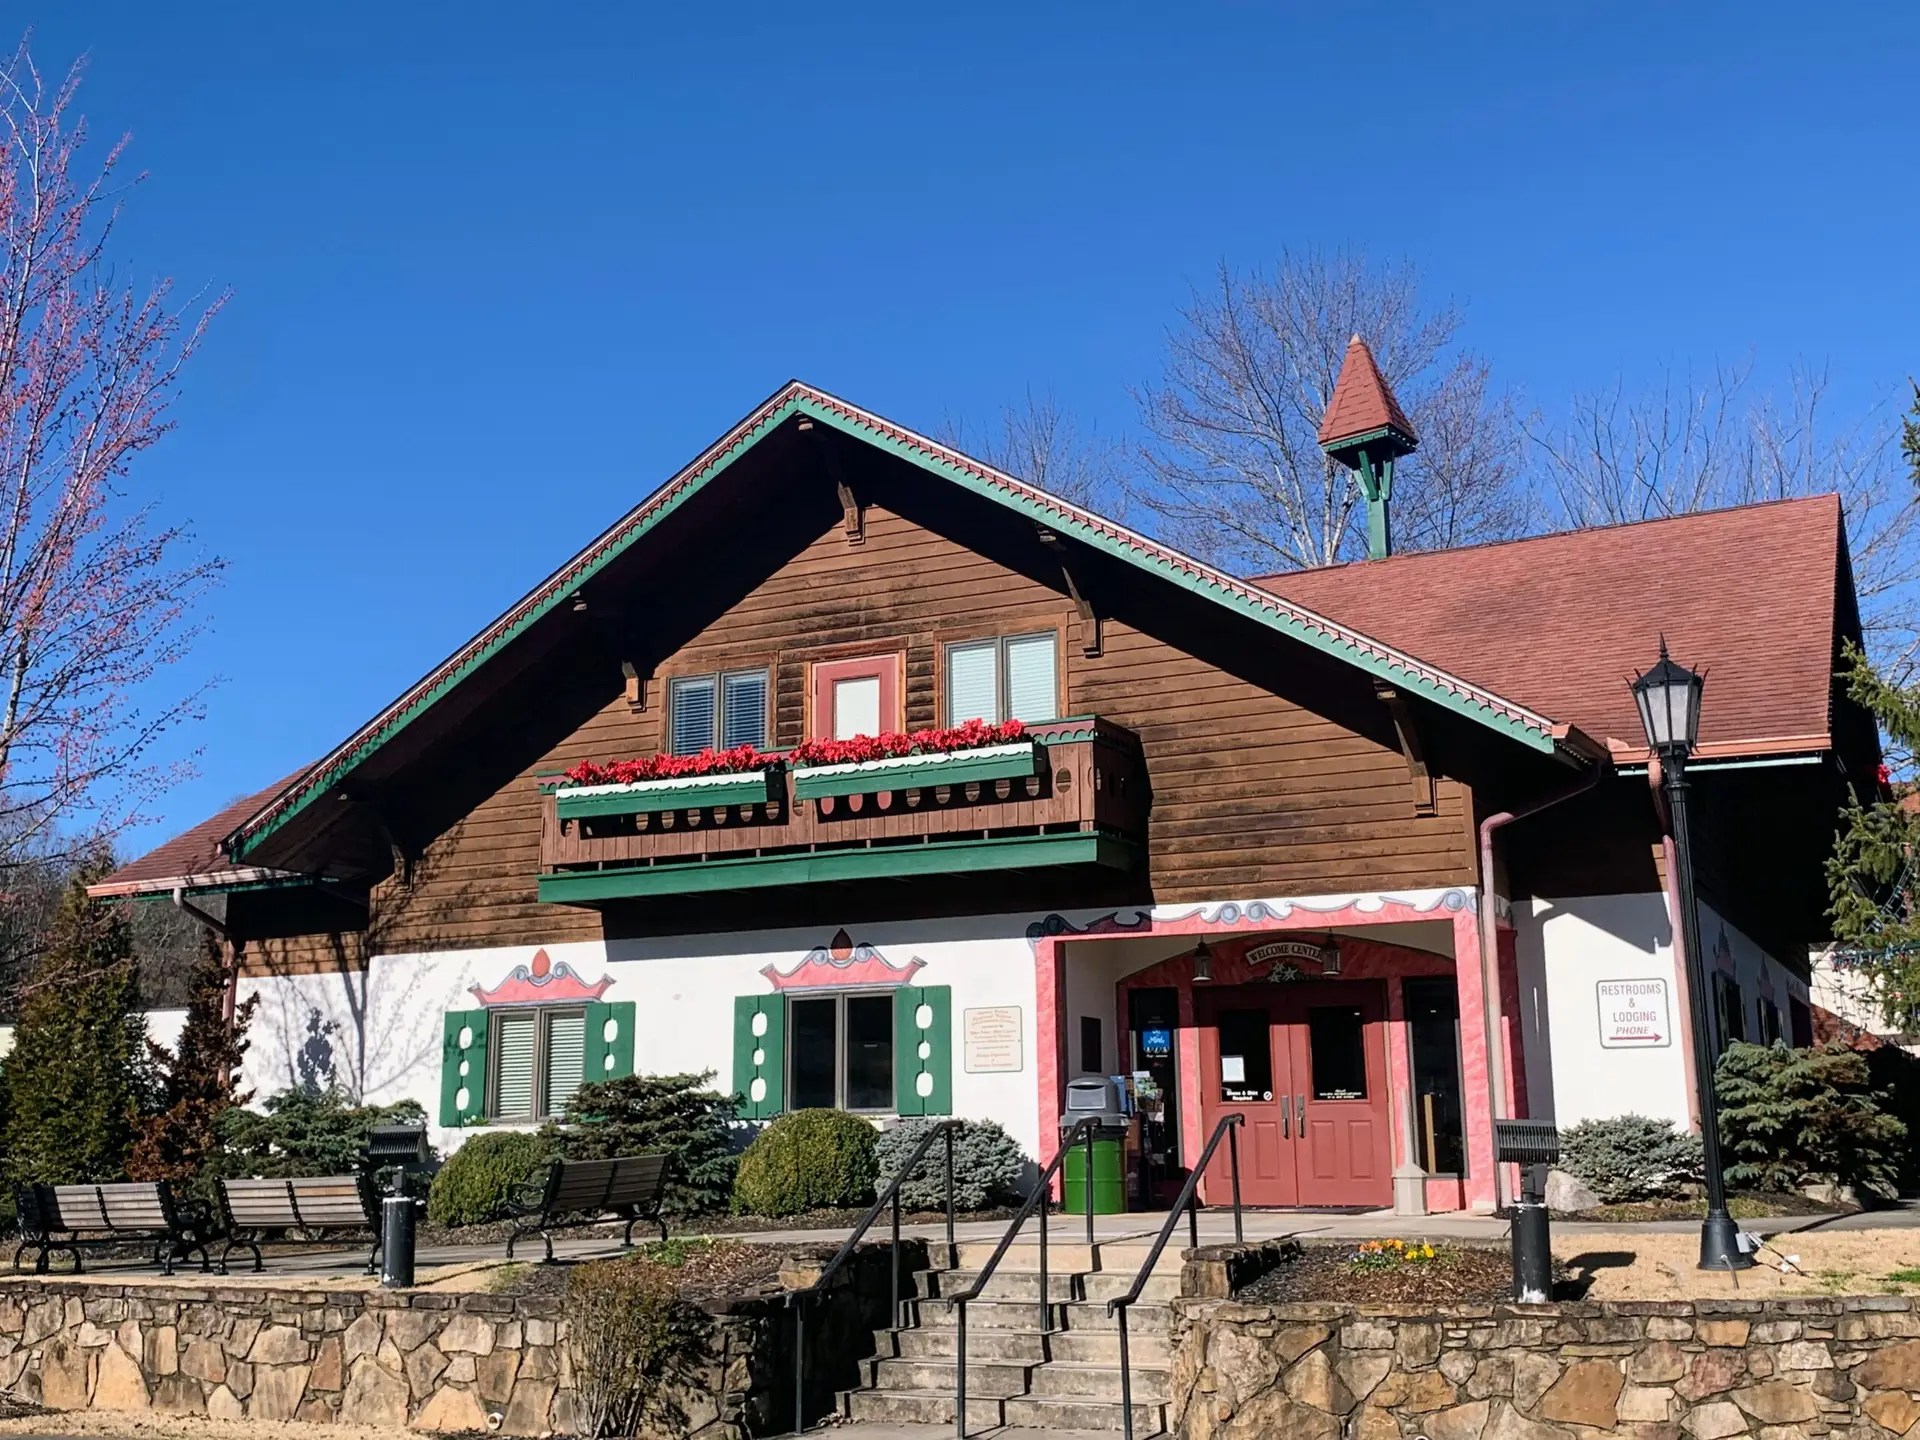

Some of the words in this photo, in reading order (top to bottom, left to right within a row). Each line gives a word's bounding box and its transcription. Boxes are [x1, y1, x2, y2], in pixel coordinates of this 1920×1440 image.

[1249, 944, 1289, 961] WELCOME
[1292, 944, 1321, 959] CENTE
[1601, 984, 1662, 996] RESTROOMS
[1628, 998, 1635, 1008] &
[1613, 1011, 1657, 1022] LODGING
[1615, 1026, 1649, 1035] PHONE
